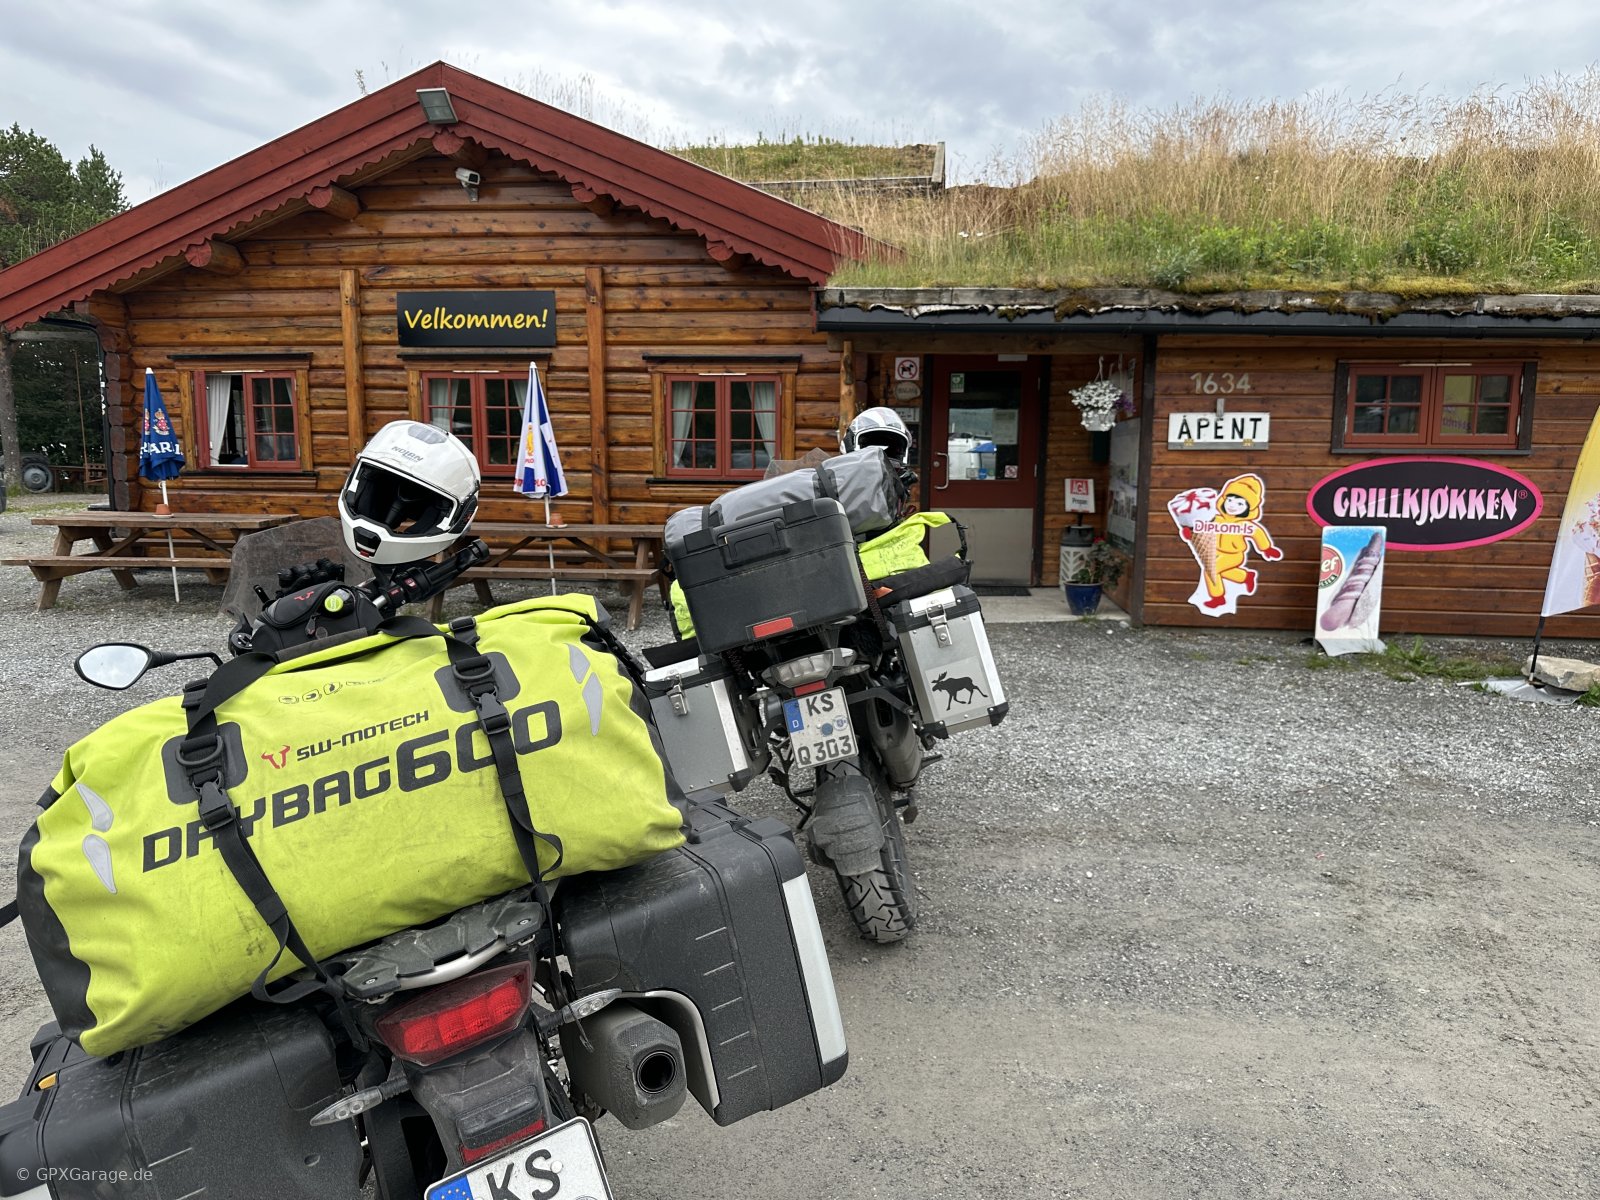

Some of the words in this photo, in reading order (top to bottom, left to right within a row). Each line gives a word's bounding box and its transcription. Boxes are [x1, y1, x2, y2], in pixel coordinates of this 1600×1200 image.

[404, 307, 548, 330] Velkommen!
[1190, 372, 1251, 395] 1634
[1177, 415, 1262, 440] ÅPENT
[391, 446, 424, 462] NOLAN
[1333, 485, 1518, 526] GRILLKJØKKEN
[805, 693, 834, 717] KS
[792, 719, 799, 728] D
[296, 710, 429, 762] SW-MOTECH
[797, 745, 812, 765] Q
[813, 735, 852, 762] 303
[486, 1149, 561, 1200] KS
